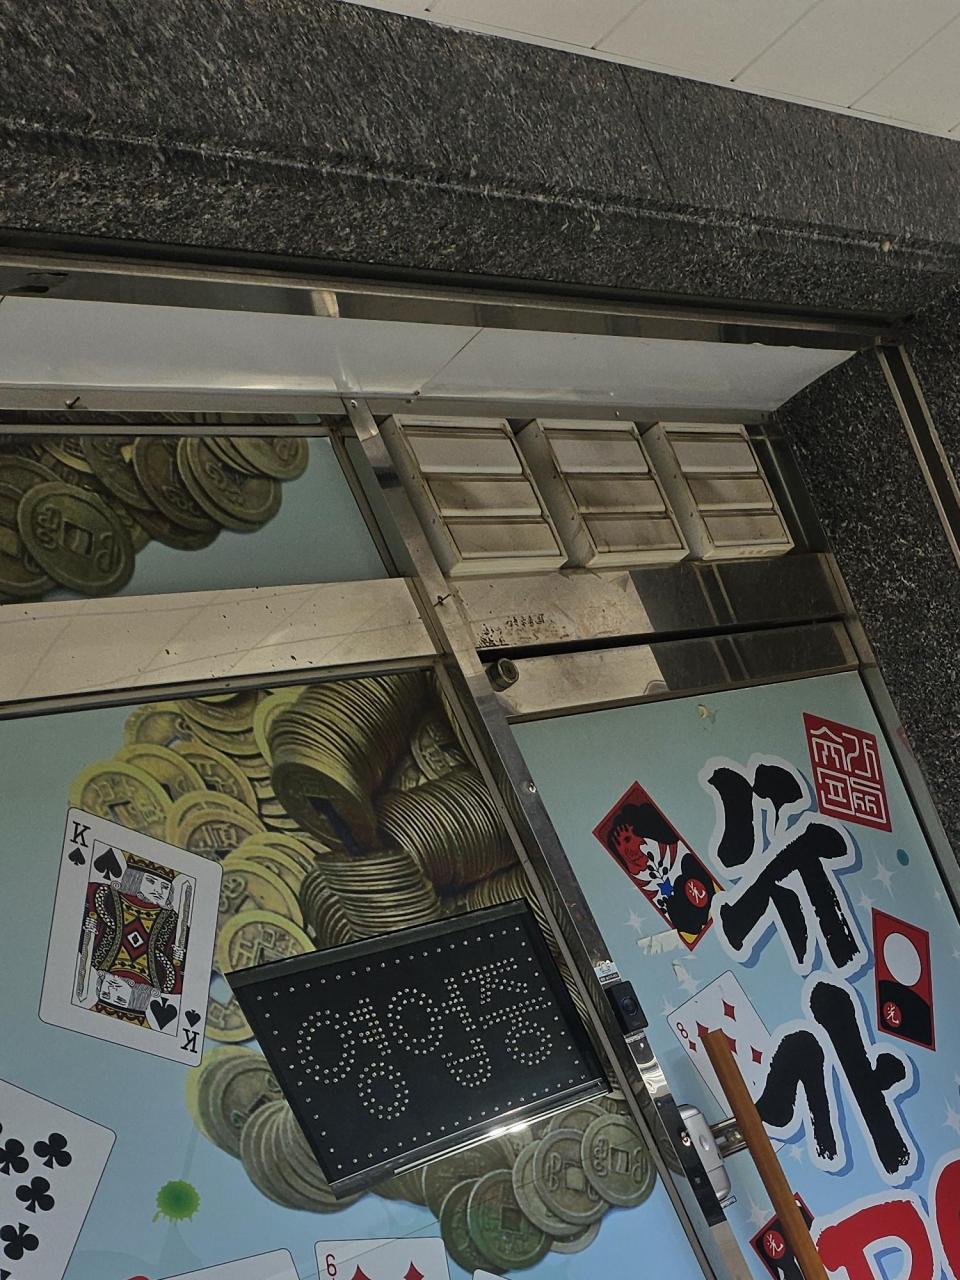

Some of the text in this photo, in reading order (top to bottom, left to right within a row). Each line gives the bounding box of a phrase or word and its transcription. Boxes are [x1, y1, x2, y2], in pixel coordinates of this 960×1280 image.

[69, 821, 91, 848] K
[703, 760, 910, 1178] 슈가
[180, 1028, 200, 1053] K
[297, 957, 552, 1121] 영업중
[676, 1021, 689, 1039] 8
[325, 1253, 337, 1277] 6
